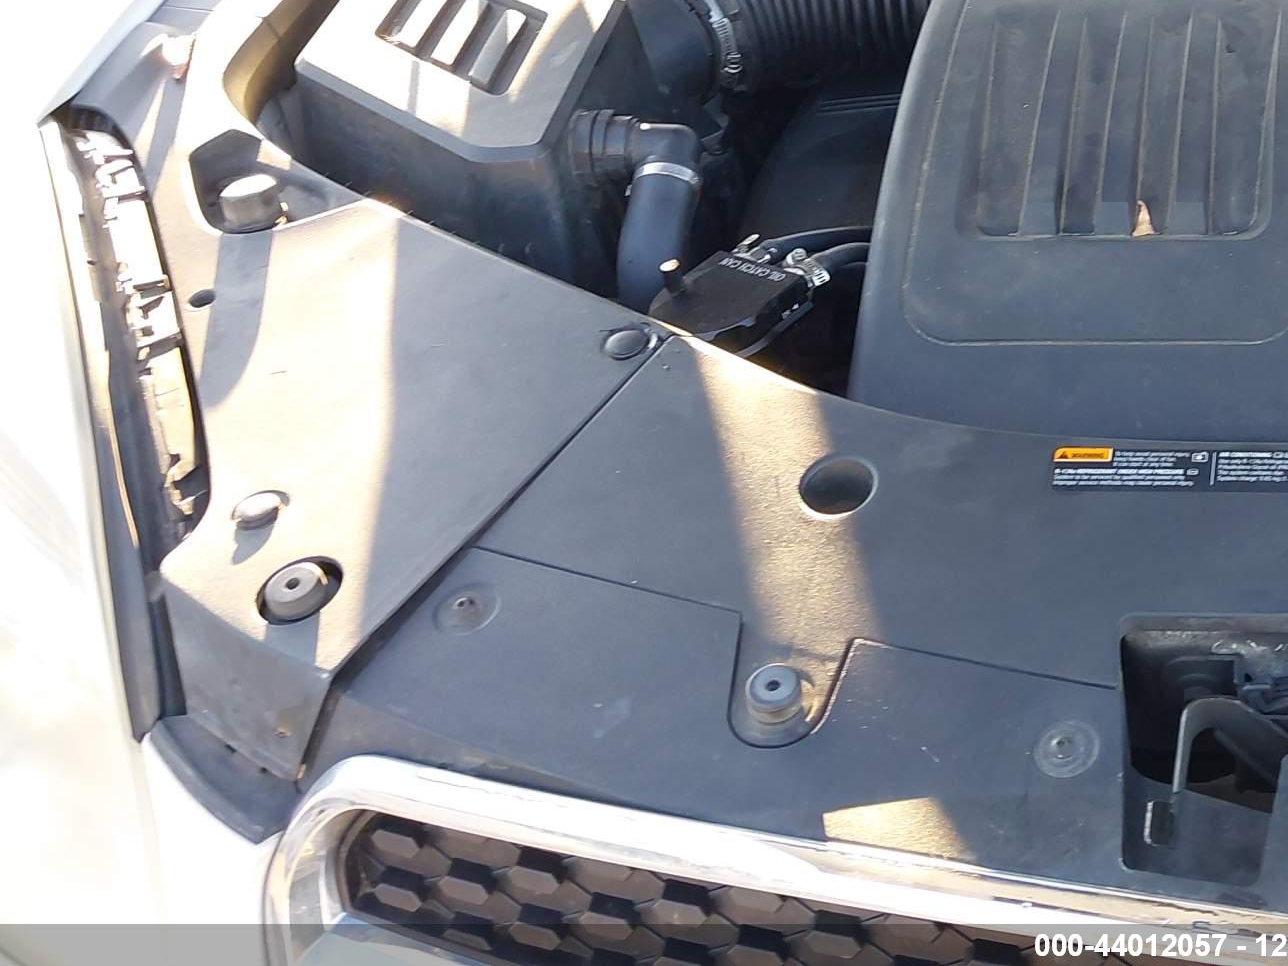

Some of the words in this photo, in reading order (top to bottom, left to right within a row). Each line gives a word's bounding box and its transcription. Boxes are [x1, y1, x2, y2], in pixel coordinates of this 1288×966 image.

[717, 257, 742, 269] CAN
[736, 262, 770, 277] CATCH
[767, 271, 786, 282] OIL
